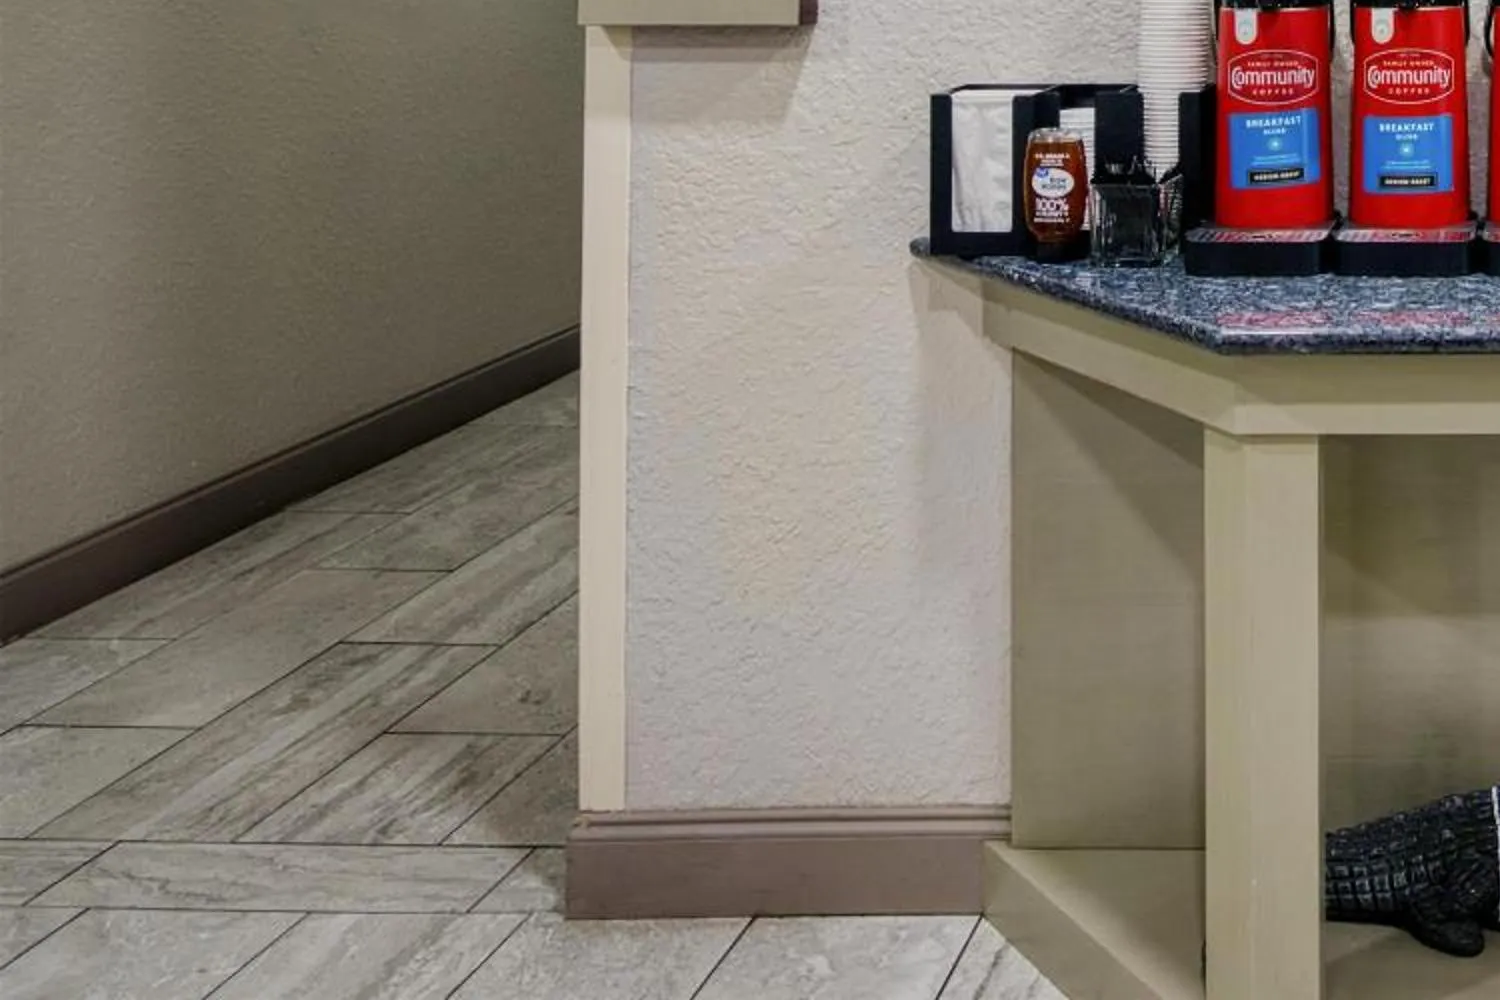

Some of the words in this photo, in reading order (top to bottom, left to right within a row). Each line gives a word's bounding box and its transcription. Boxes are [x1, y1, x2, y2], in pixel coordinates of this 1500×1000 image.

[1231, 66, 1316, 90] Community
[1367, 65, 1451, 90] Community
[1245, 115, 1302, 129] BREAKFAST
[1379, 123, 1435, 133] BREAKFAST
[1035, 198, 1070, 211] 100%
